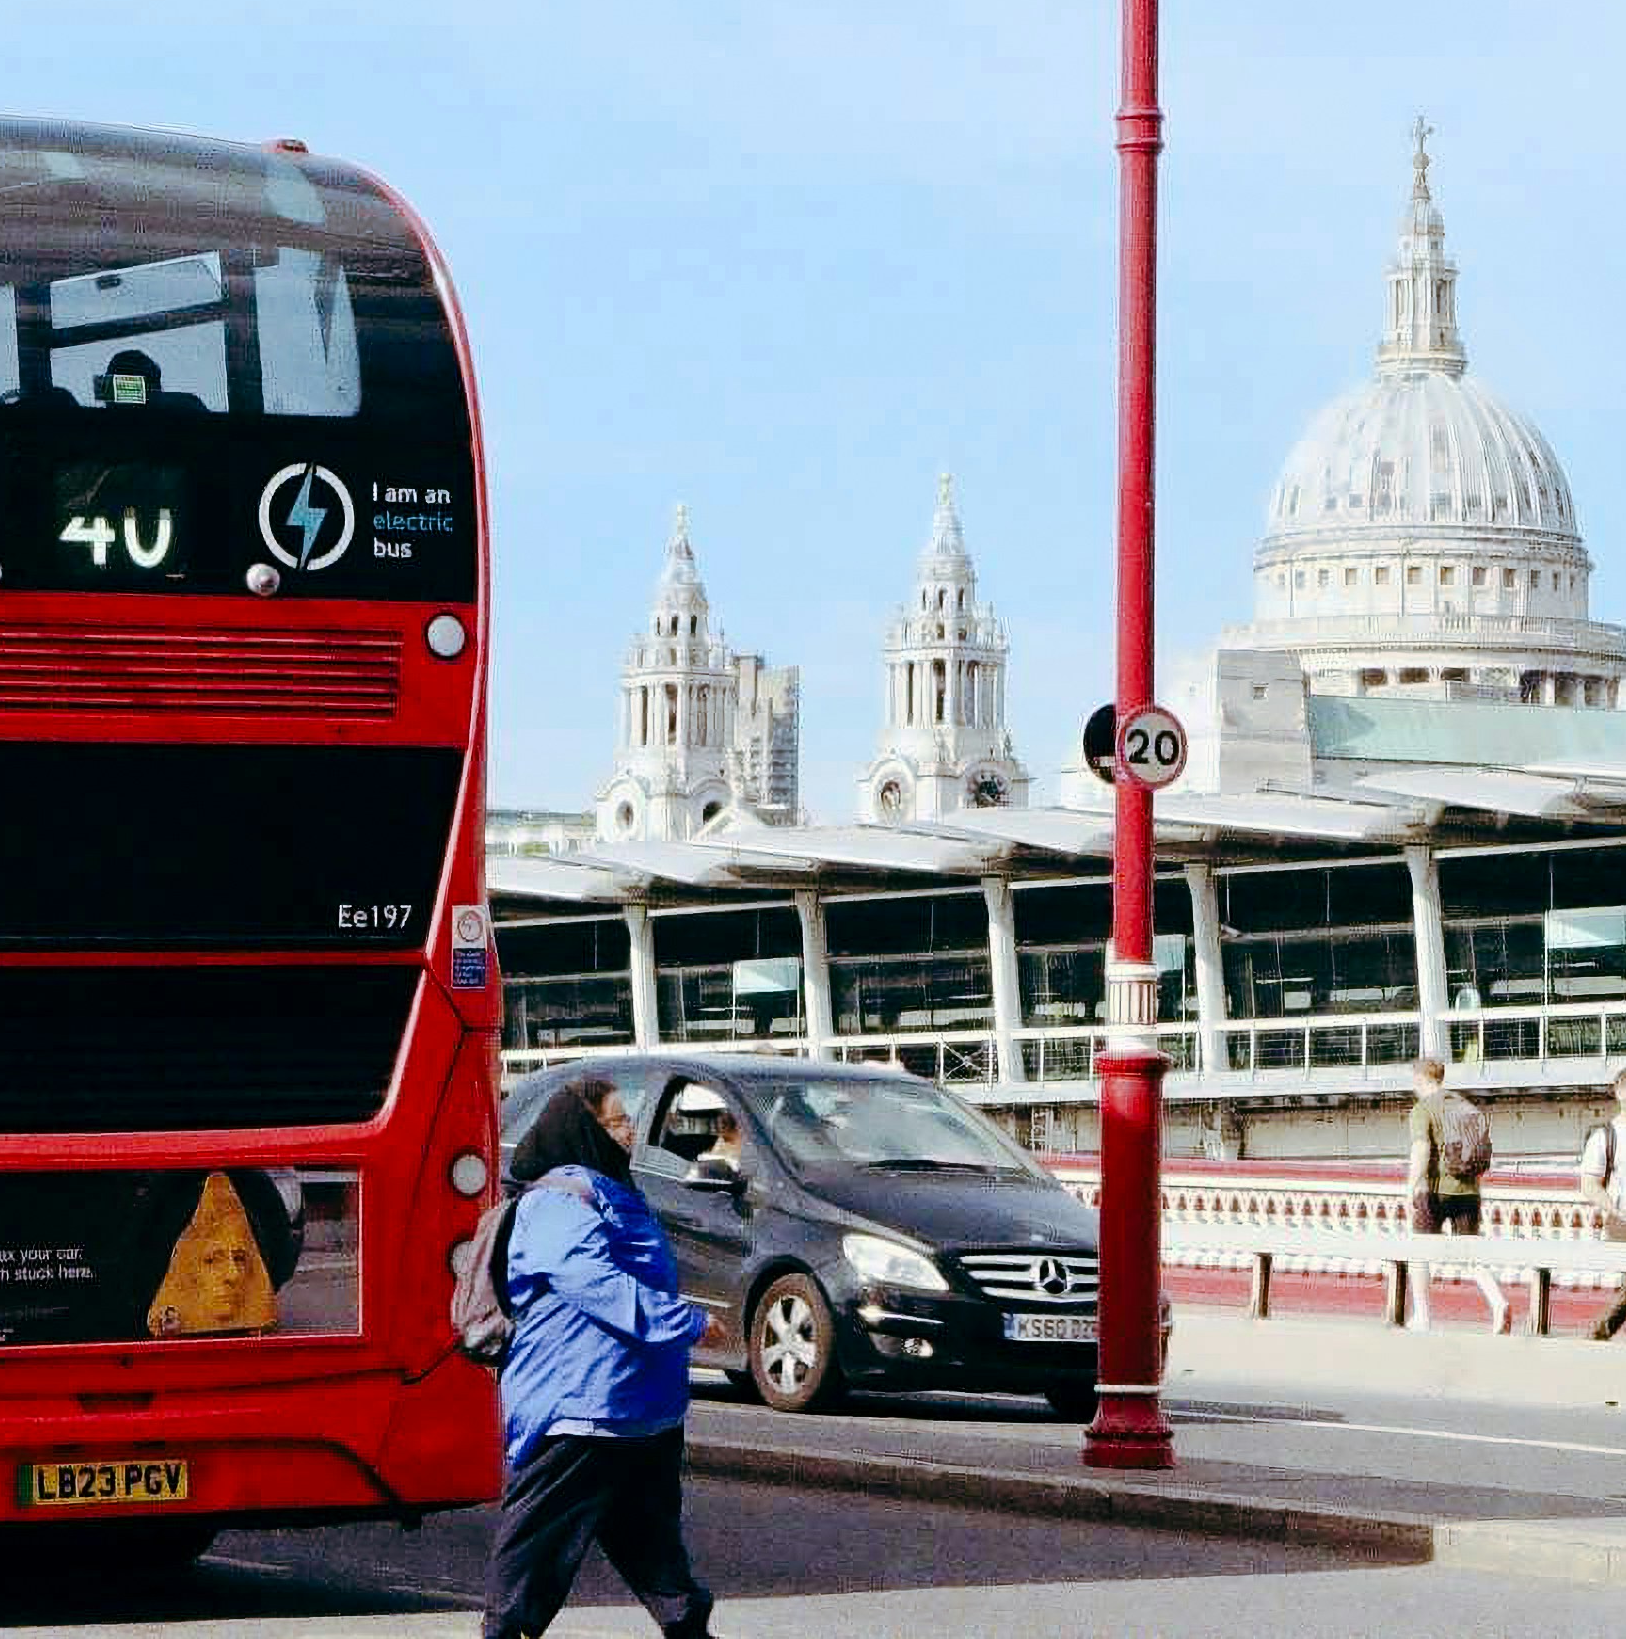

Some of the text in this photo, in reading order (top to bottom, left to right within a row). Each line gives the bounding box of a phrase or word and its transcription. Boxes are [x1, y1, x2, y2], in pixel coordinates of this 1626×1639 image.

[385, 487, 418, 503] am
[425, 487, 452, 504] an
[373, 511, 454, 533] electric
[373, 538, 413, 559] bus
[1127, 728, 1181, 766] 20
[338, 904, 413, 930] Ee197
[19, 1248, 51, 1264] your
[37, 1463, 182, 1499] LB23 PGV
